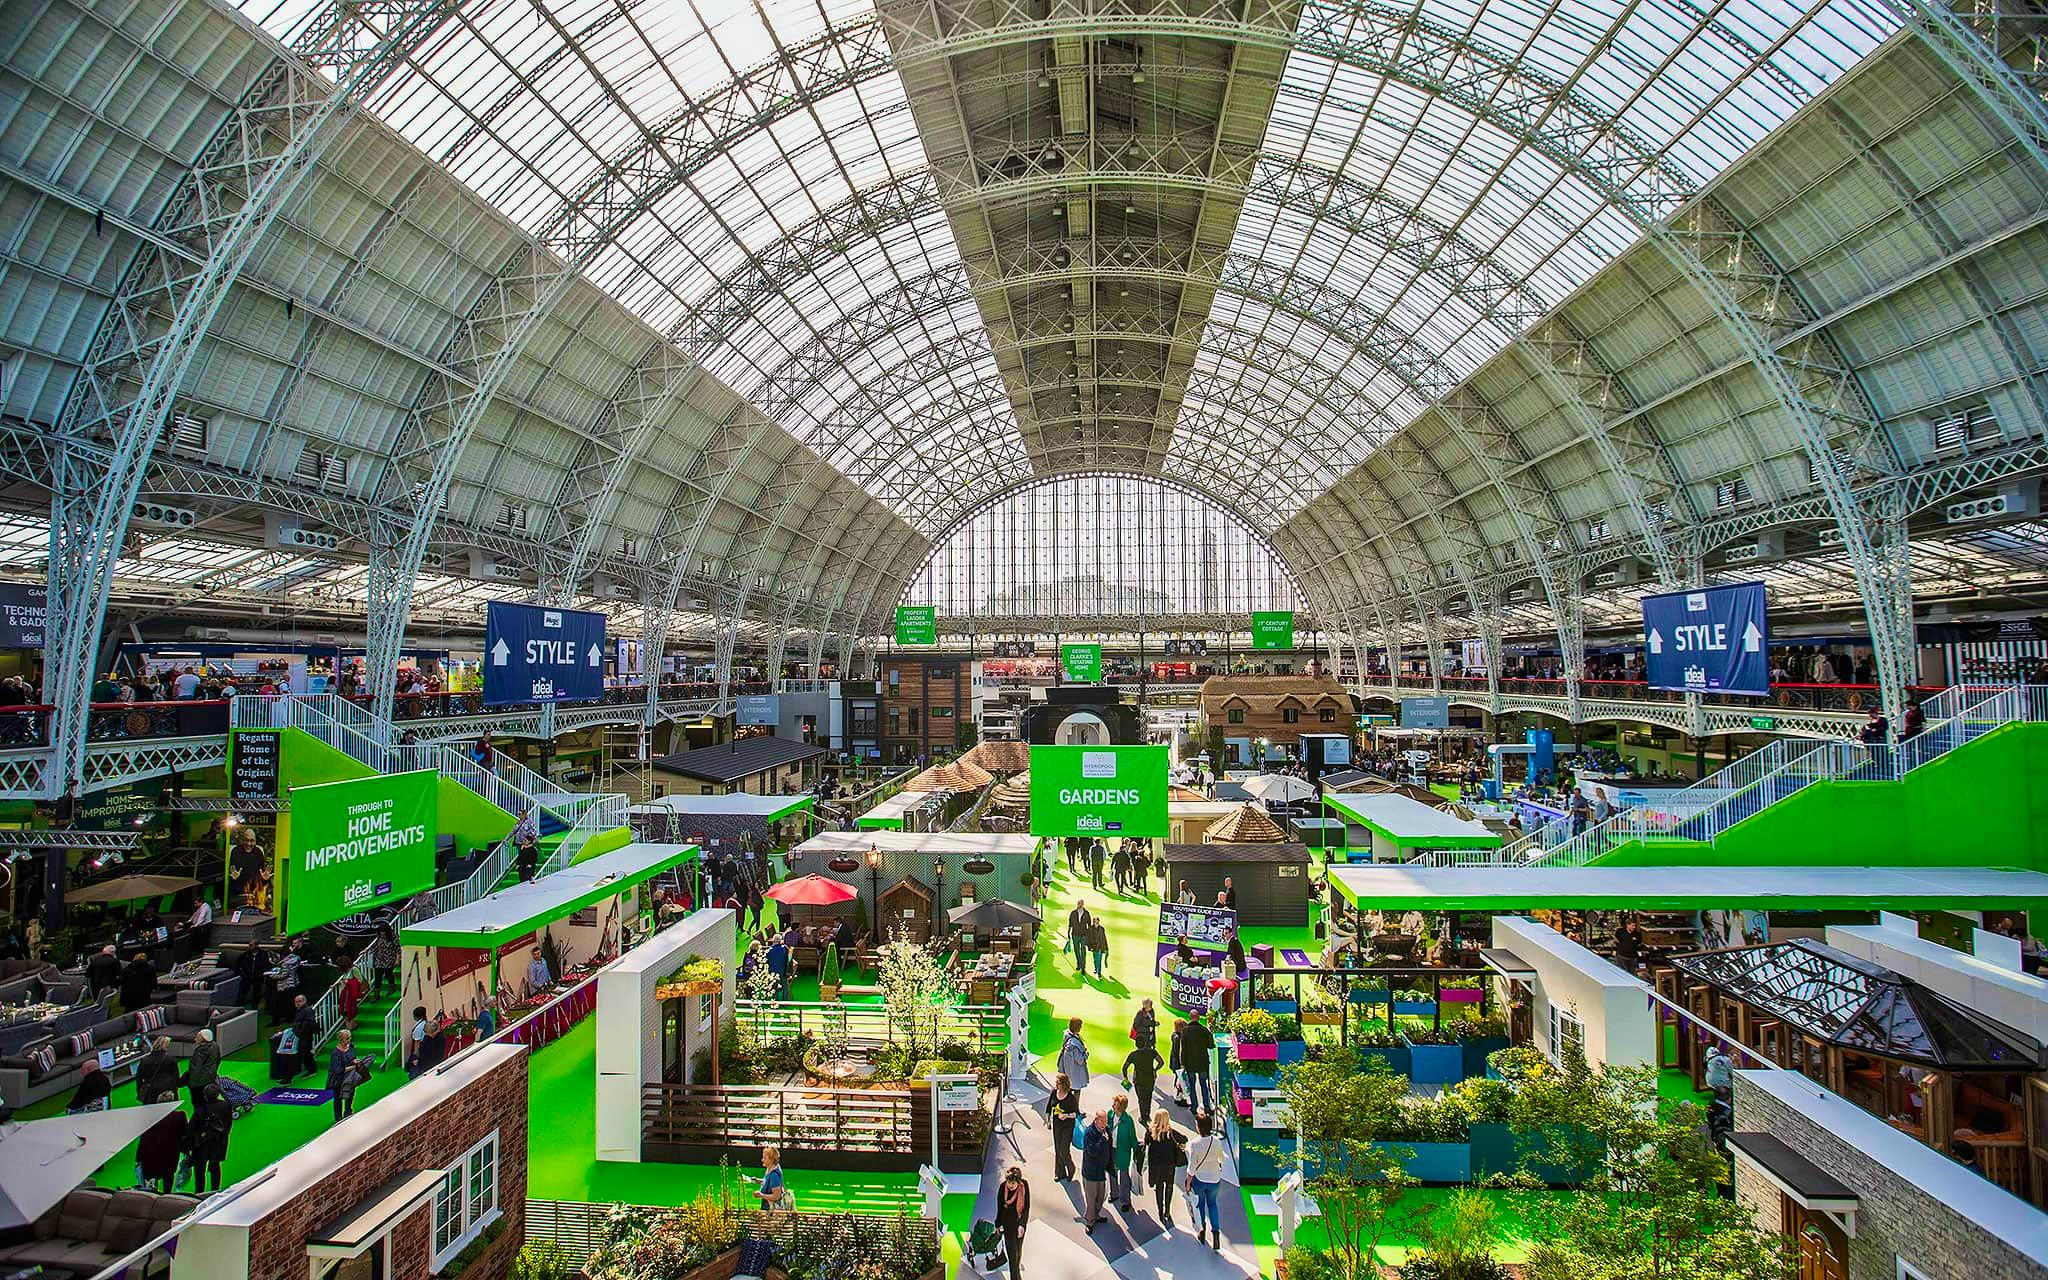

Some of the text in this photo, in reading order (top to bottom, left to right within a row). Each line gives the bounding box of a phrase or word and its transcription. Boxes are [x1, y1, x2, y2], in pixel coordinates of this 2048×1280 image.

[3, 604, 47, 617] TECHNO
[9, 615, 18, 626] &
[1675, 624, 1728, 651] STYLE
[526, 639, 575, 665] STYLE
[1684, 666, 1706, 683] ideal
[532, 679, 553, 695] ideal
[239, 733, 275, 744] Regatta
[242, 745, 270, 753] Home
[241, 757, 270, 765] of the
[236, 768, 274, 778] Original
[1059, 788, 1140, 805] GARDENS
[348, 799, 394, 815] THROUGH TO
[248, 815, 269, 824] Grill
[348, 812, 393, 839] HOME
[1076, 815, 1103, 828] ideal
[305, 825, 425, 872] IMPROVEMENTS
[344, 879, 373, 902] ideal
[1178, 983, 1207, 996] SOUV
